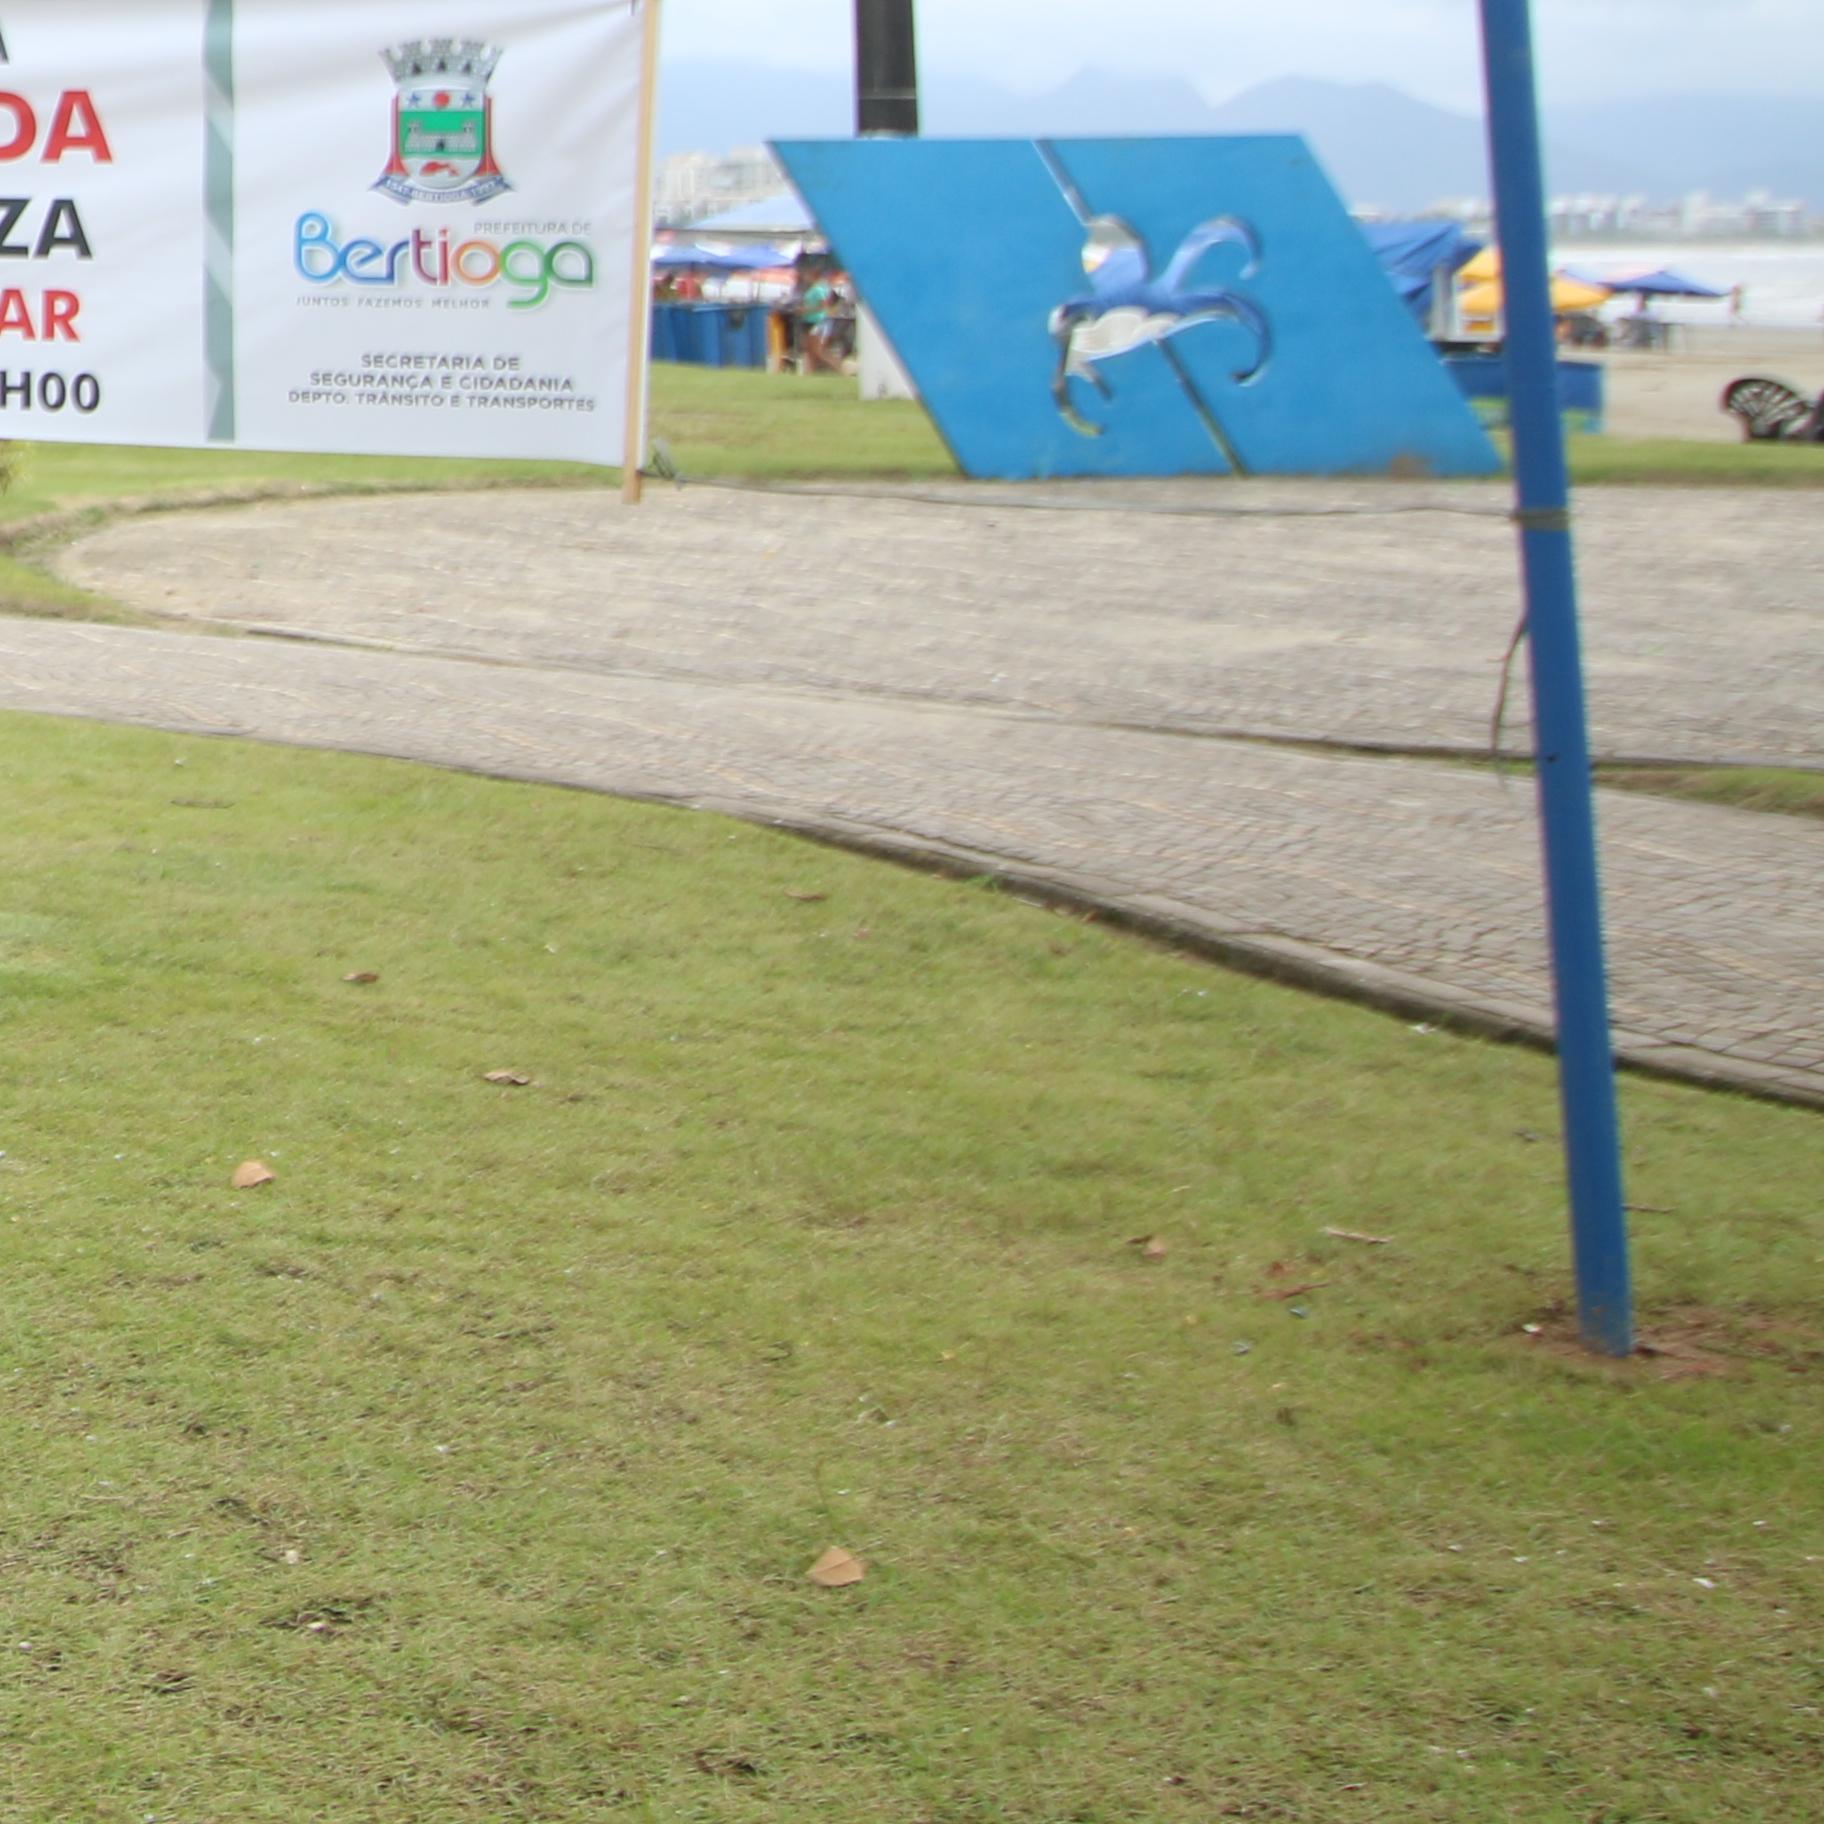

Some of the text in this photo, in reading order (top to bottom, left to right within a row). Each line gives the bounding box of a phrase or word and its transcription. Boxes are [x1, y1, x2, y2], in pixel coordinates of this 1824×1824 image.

[474, 222, 591, 236] PREFEITURA DE
[294, 212, 594, 310] Bertioga
[296, 296, 490, 310] JUNTOS FAZEMOS MELHOR
[360, 354, 520, 371] SECRETARIA DE
[309, 372, 574, 392] SEGURANÇA E CIDADANIA
[288, 391, 595, 412] DEPTO. TRÂNSITO E TRANSPORTES
